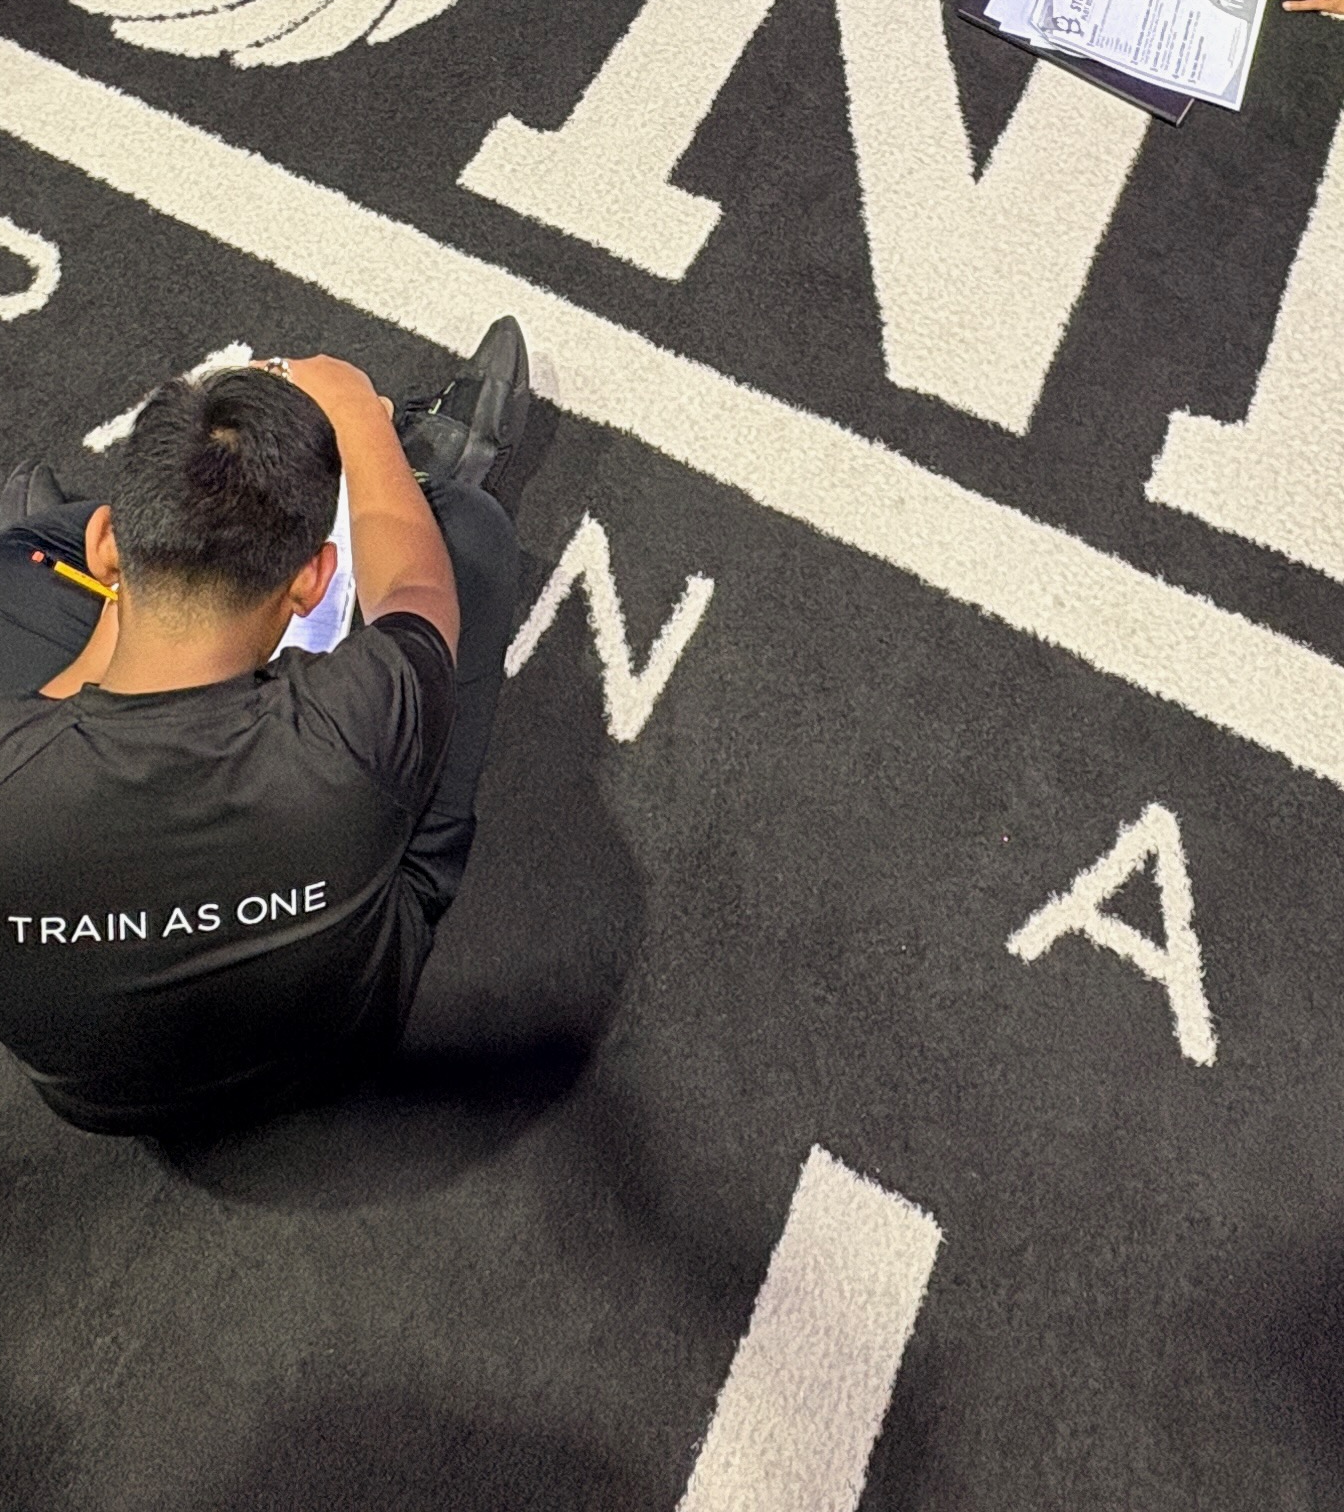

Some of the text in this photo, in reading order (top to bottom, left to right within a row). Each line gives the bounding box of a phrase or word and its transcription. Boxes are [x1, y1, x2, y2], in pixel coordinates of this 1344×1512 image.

[8, 880, 327, 944] TRAIN AS ONE
